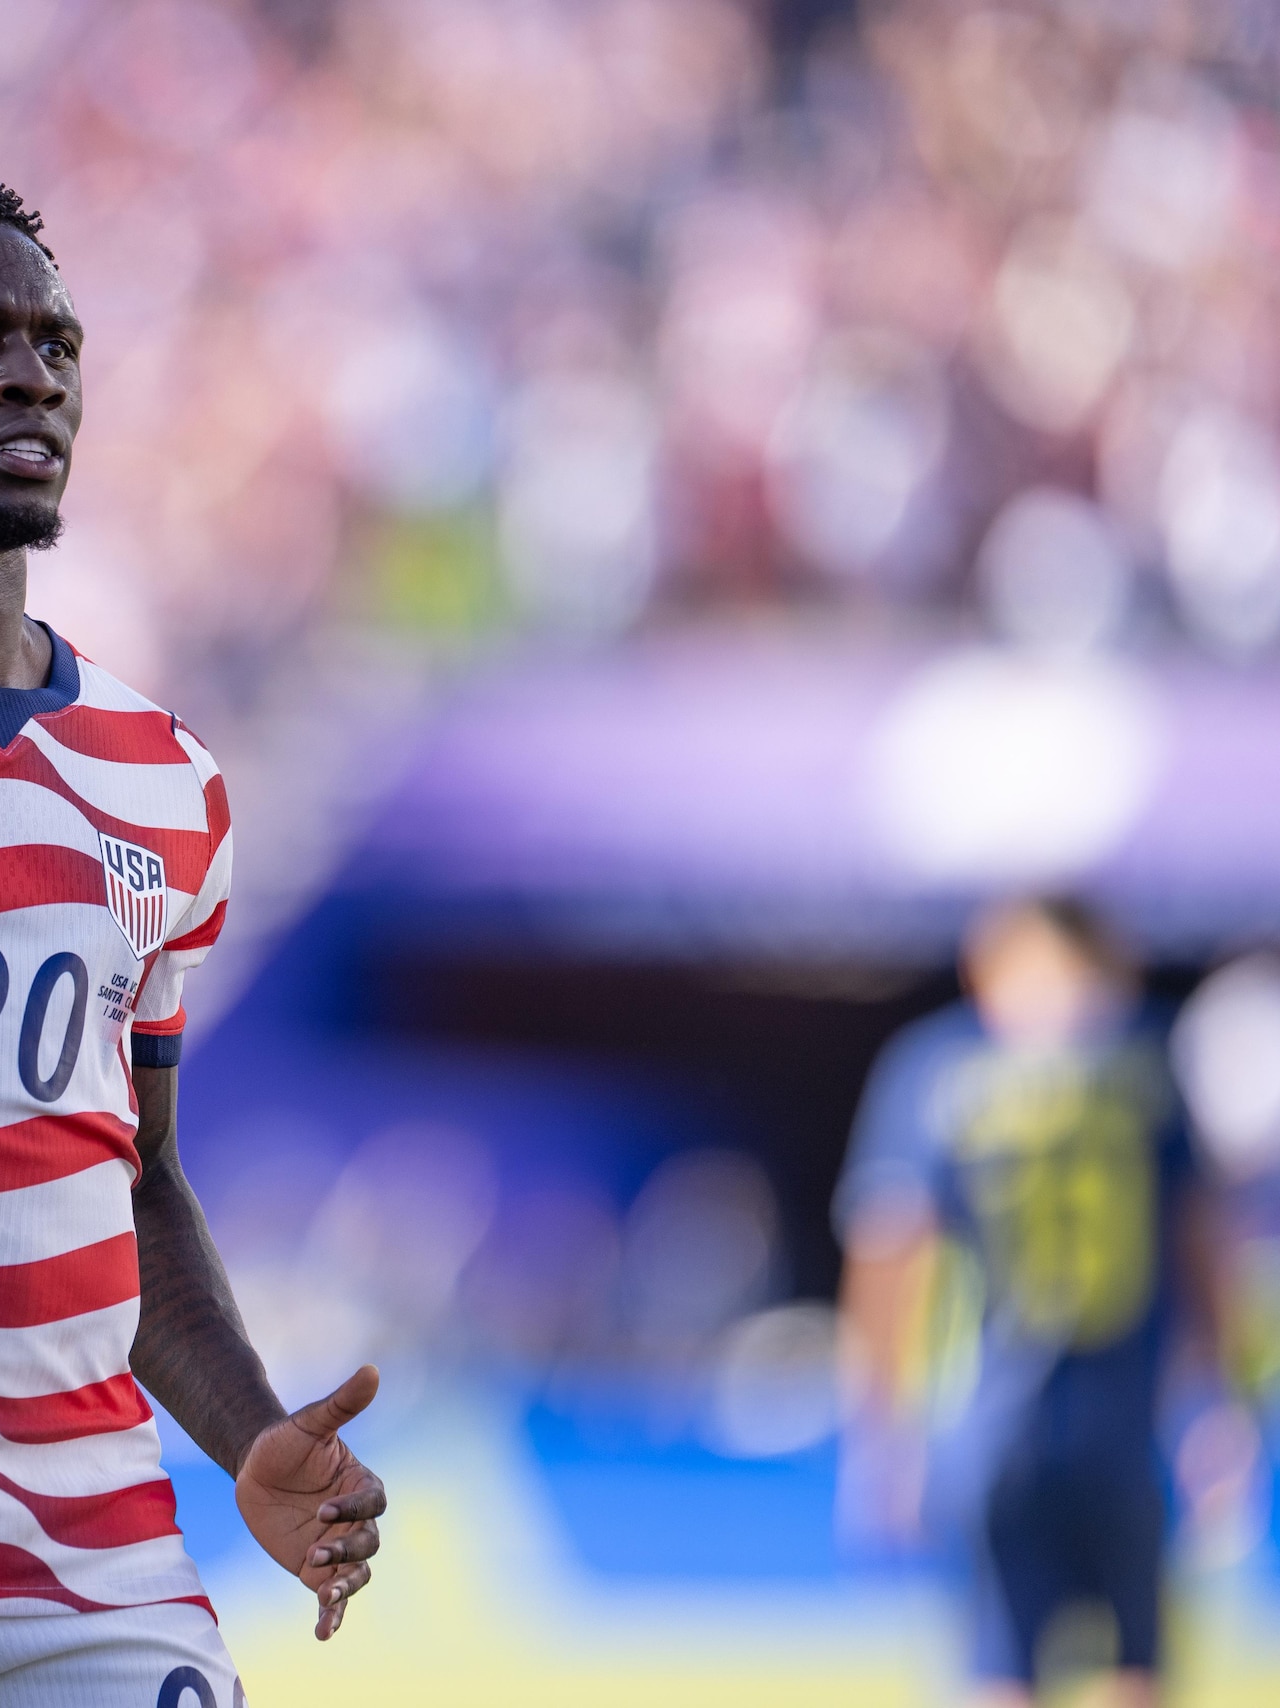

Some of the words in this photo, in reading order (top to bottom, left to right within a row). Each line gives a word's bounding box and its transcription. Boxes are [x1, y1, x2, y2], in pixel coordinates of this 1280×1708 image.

[104, 840, 162, 892] USA
[111, 973, 129, 989] USA
[97, 985, 124, 1005] SANTA
[124, 996, 132, 1009] CL
[103, 1004, 109, 1016] 1
[108, 1007, 128, 1023] JULY
